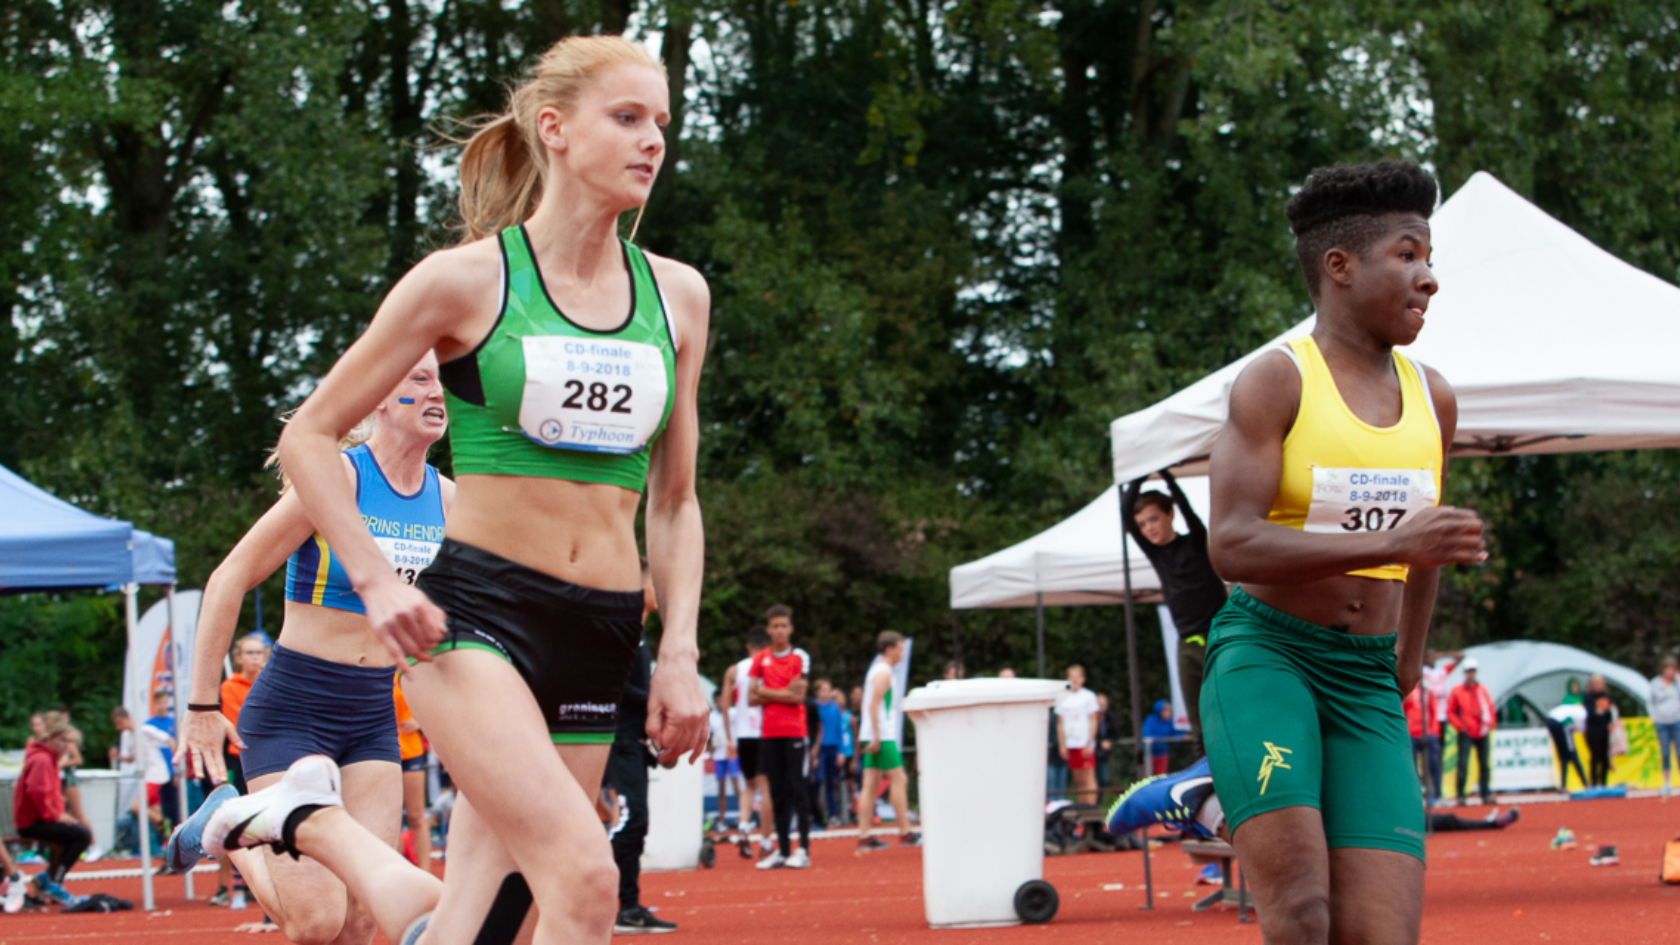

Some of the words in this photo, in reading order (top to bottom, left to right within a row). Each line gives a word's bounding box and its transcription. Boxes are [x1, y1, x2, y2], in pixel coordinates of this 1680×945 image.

[564, 342, 632, 358] CD-finale
[567, 361, 631, 376] 8-9-2018
[561, 379, 633, 414] 282
[571, 425, 635, 443] Typhoon
[1349, 473, 1410, 486] CD-finale
[1349, 490, 1408, 502] 8-9-2018
[361, 514, 401, 537] PRINS
[1341, 507, 1408, 531] 307
[394, 543, 431, 554] CD-finale
[394, 554, 430, 566] 8-9-2018
[396, 568, 416, 585] 13
